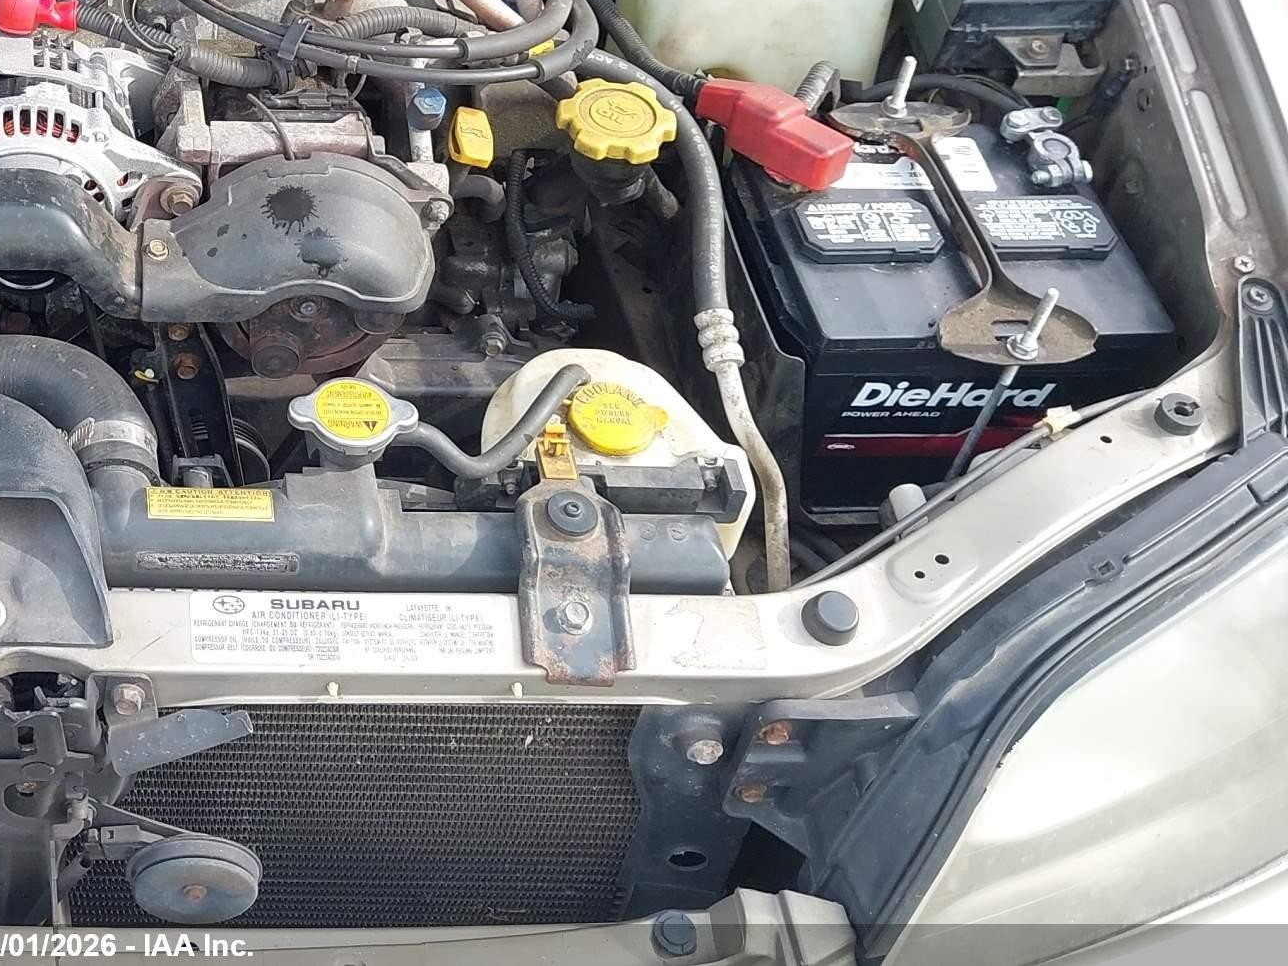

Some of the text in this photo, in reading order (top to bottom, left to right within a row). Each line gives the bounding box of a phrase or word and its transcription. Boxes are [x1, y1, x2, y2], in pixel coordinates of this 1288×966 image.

[576, 383, 645, 408] COOLANT
[850, 381, 1057, 408] DieHard
[327, 419, 363, 429] WARNING
[270, 599, 360, 611] SUBARU
[251, 611, 266, 620] AIR
[269, 611, 326, 620] CONDITIONER
[399, 613, 446, 622] CLIMATISEUR
